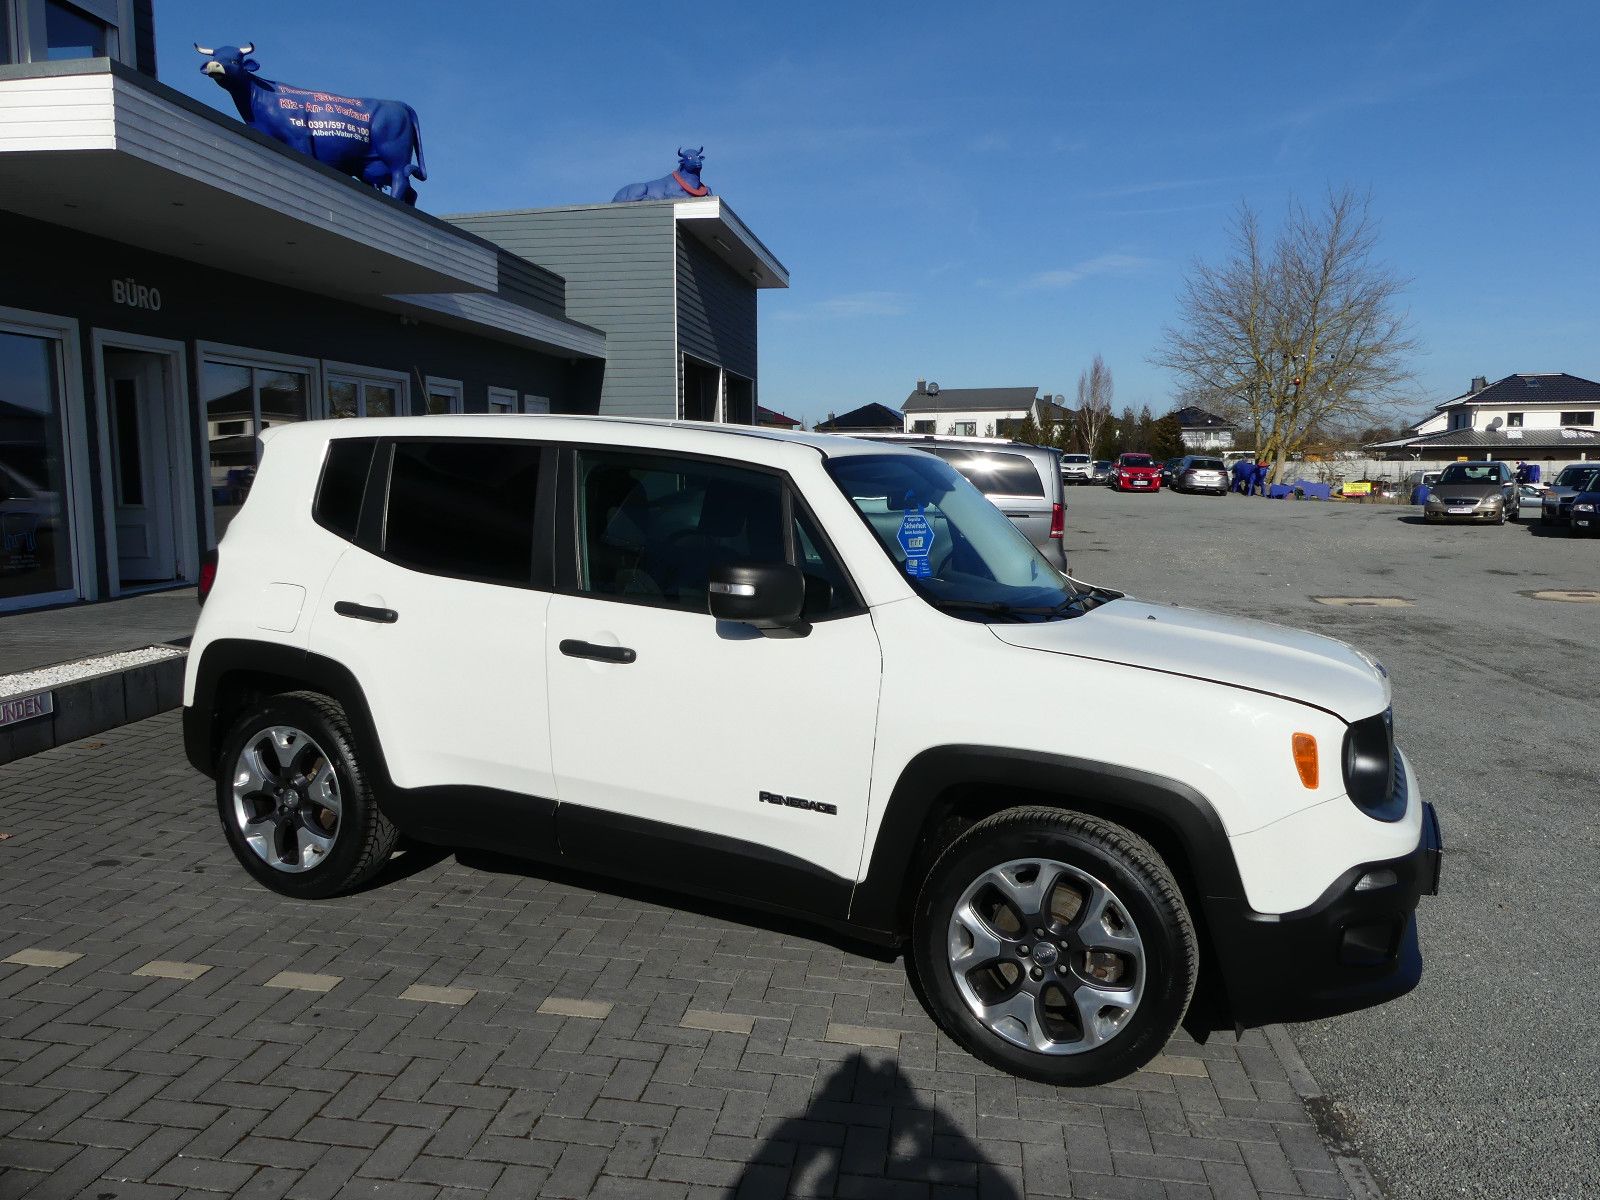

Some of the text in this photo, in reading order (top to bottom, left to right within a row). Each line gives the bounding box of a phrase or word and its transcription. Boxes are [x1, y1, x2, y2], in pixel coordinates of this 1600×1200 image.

[289, 118, 306, 127] Tel.
[308, 120, 346, 130] 0391/597
[111, 278, 161, 311] BÜRO
[759, 790, 837, 816] RENEGADE
